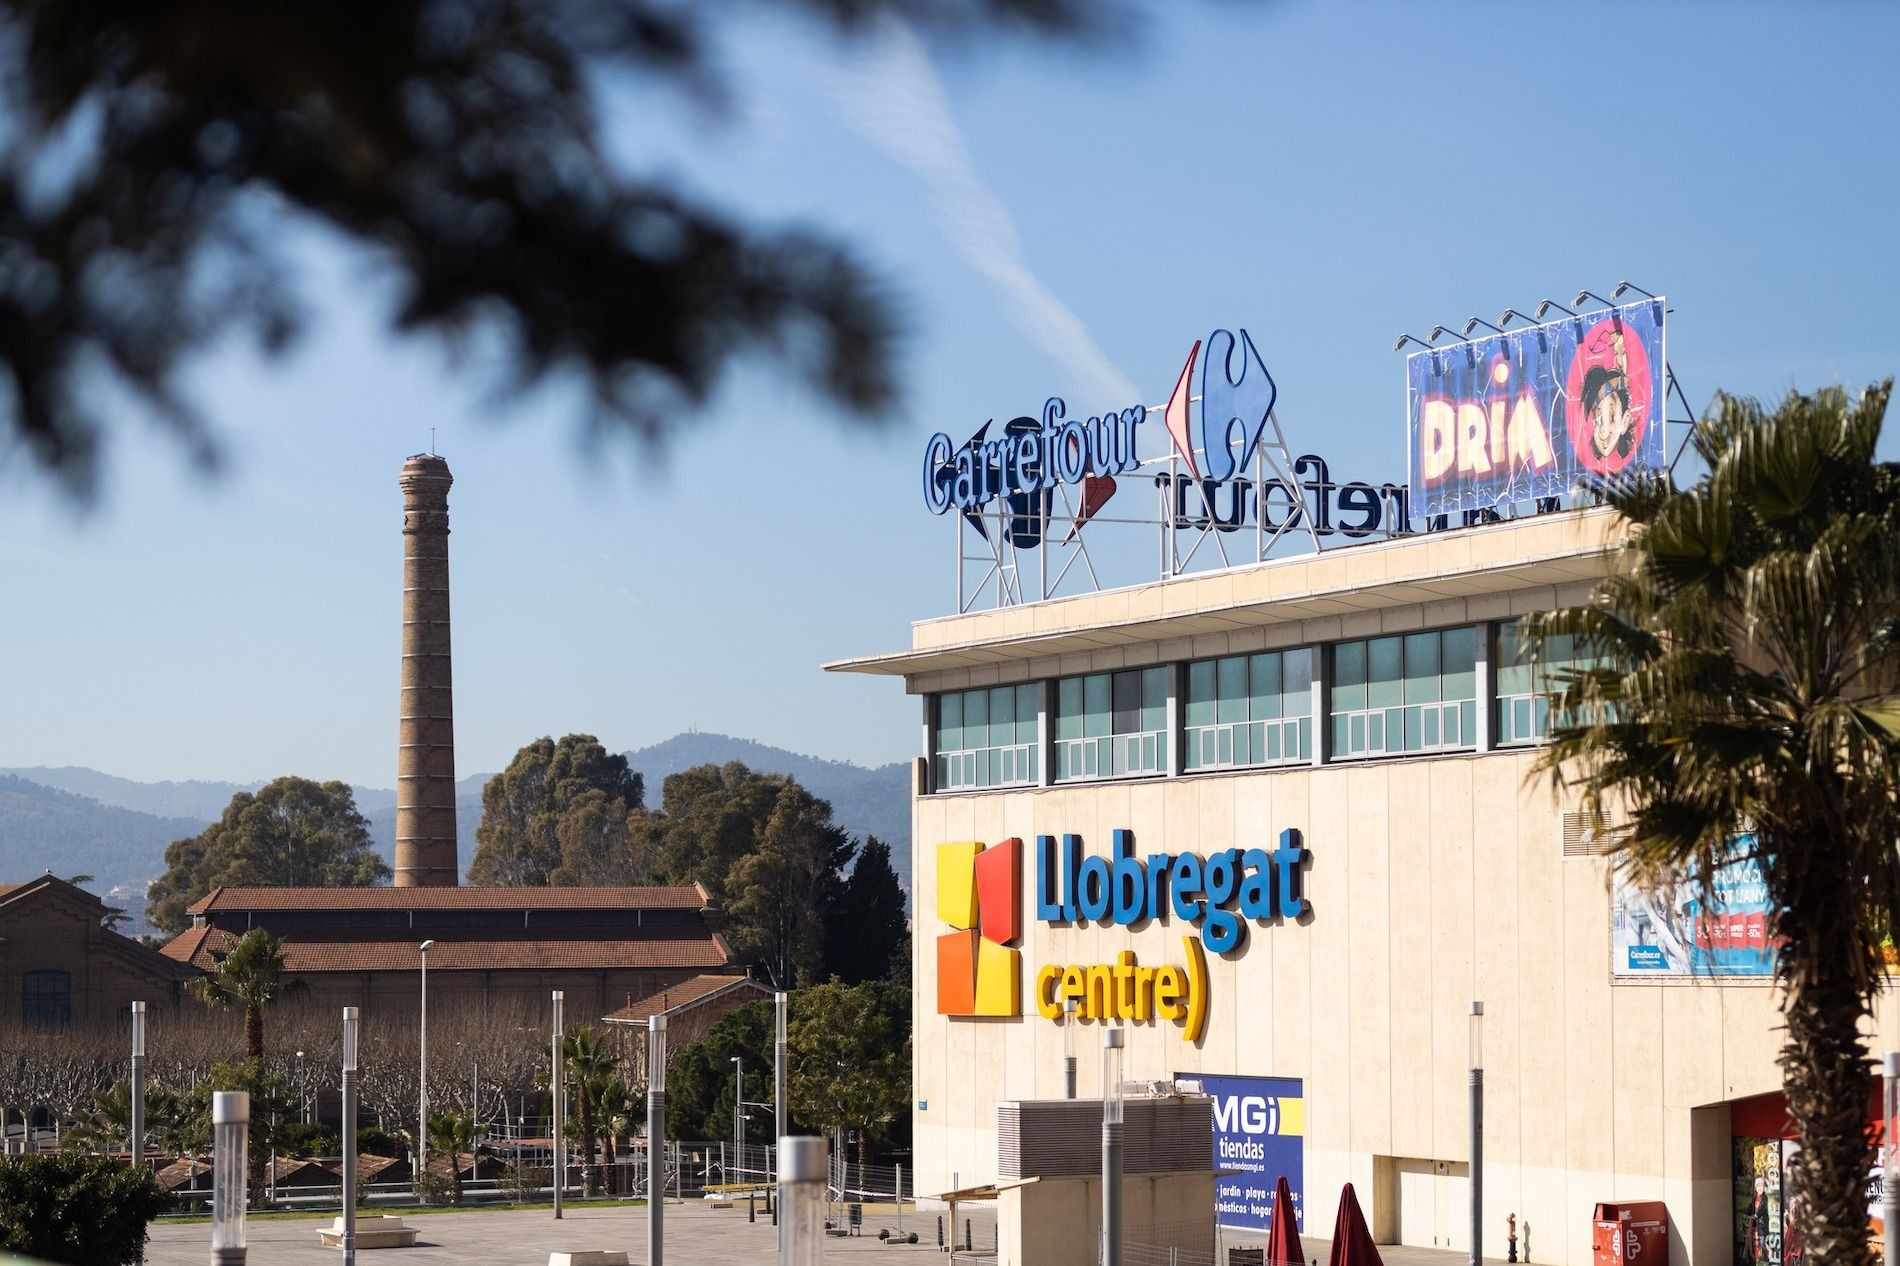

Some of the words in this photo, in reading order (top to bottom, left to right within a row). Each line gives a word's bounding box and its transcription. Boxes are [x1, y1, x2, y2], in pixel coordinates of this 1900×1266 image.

[923, 397, 1147, 515] Carrefour
[1037, 828, 1309, 953] Llobregat
[1219, 1135, 1265, 1161] tiendas
[1219, 1184, 1241, 1199] jardín
[1245, 1186, 1266, 1201] playa
[1250, 1203, 1272, 1218] hogar
